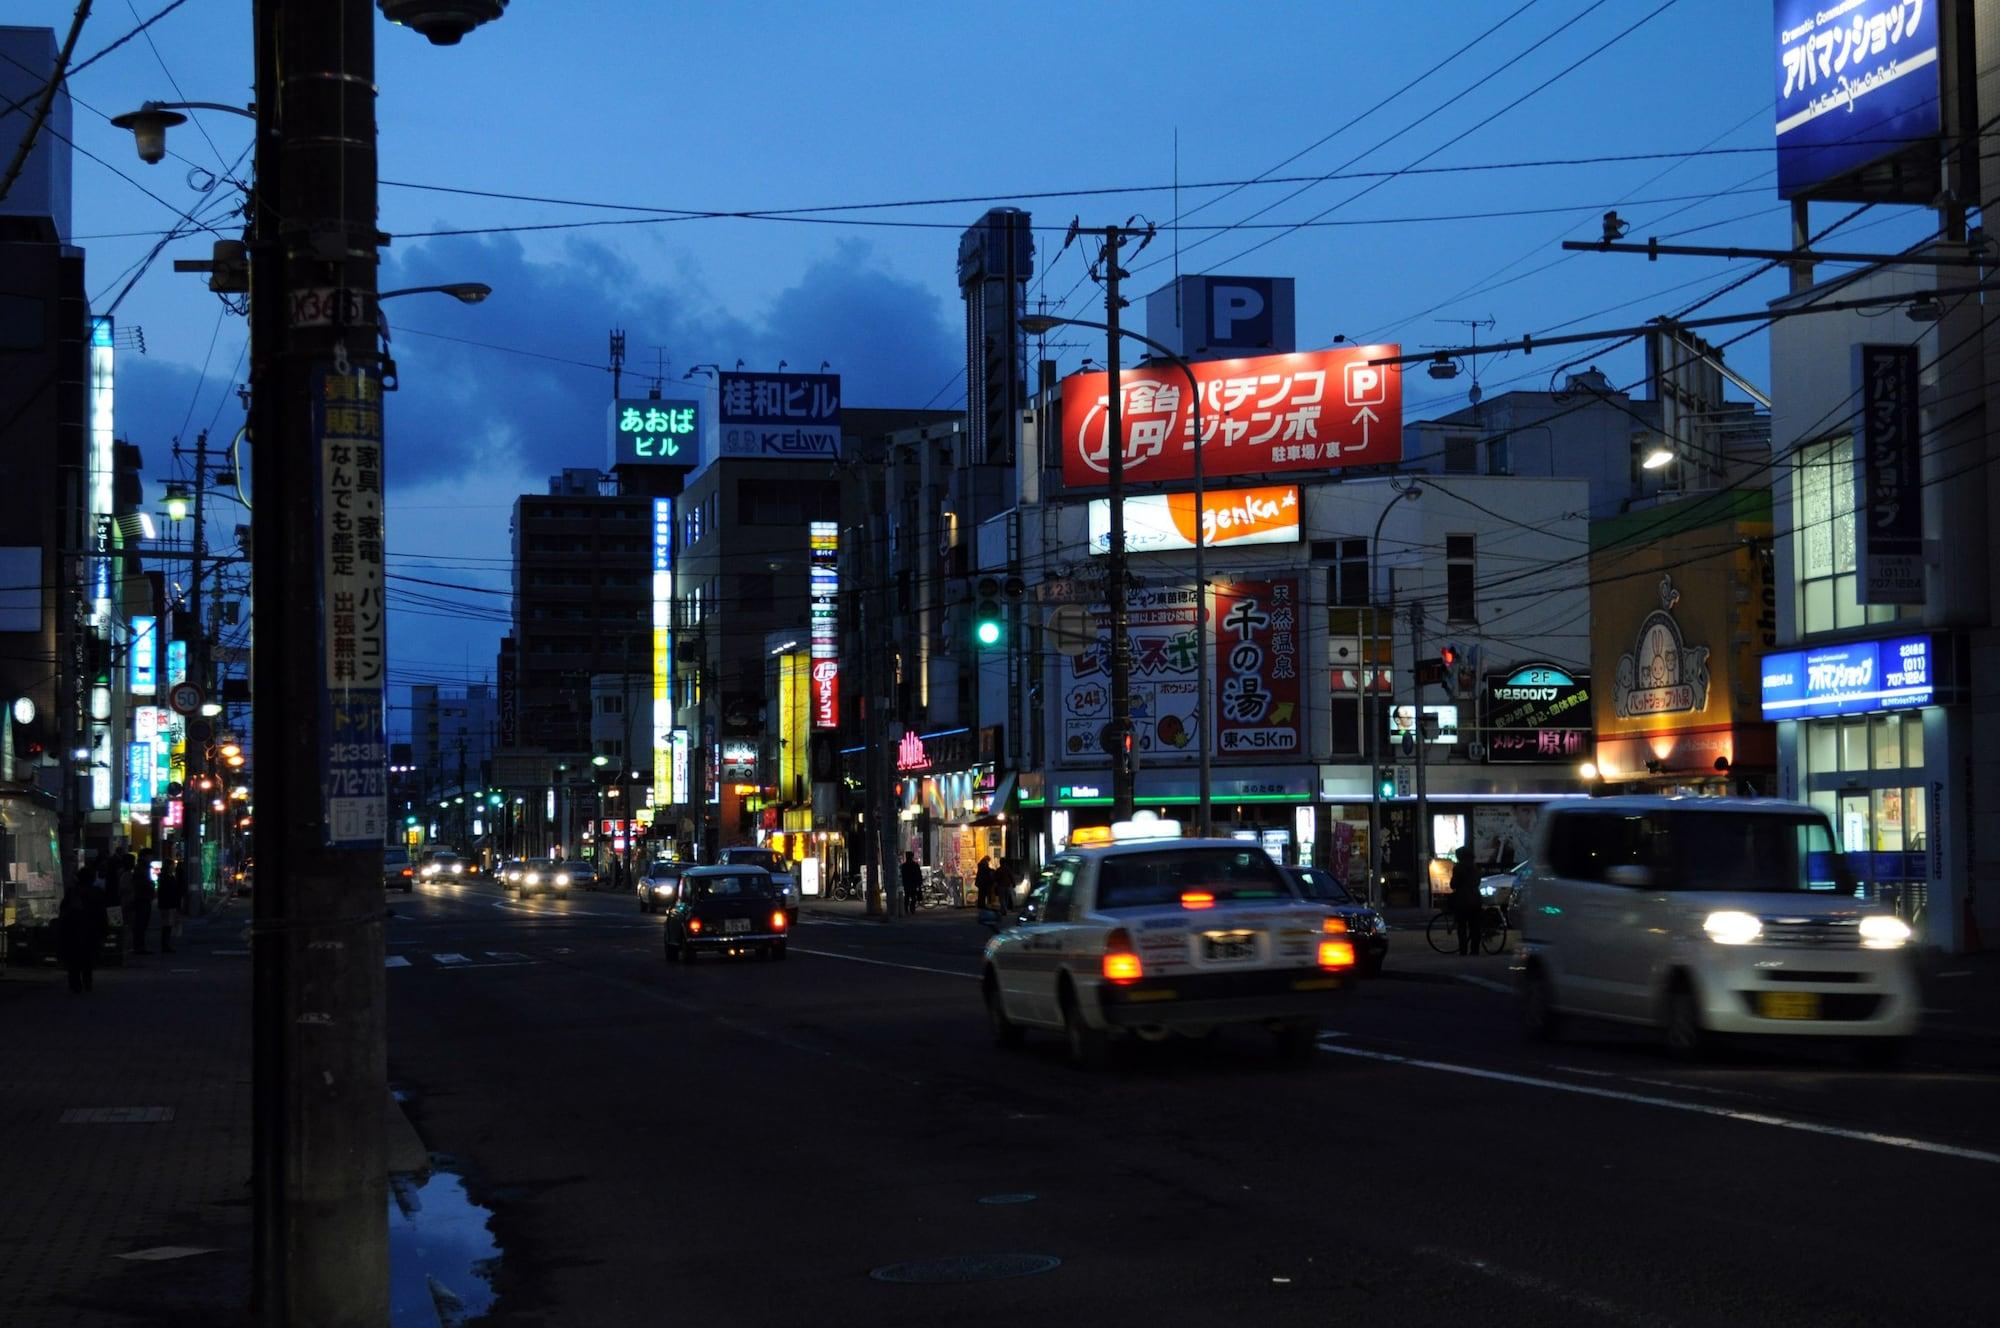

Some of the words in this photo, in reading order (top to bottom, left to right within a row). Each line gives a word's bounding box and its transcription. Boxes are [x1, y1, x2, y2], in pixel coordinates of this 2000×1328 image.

[1213, 286, 1265, 340] P
[723, 378, 838, 418] 桂和ビル
[1127, 384, 1180, 415] 全台
[1187, 370, 1327, 414] パチンコ
[619, 406, 696, 434] あおば
[1183, 405, 1322, 451] ジャンボ
[635, 436, 680, 457] ビル
[1271, 585, 1296, 680] 天然温泉
[1225, 600, 1268, 718] 千の湯
[1531, 672, 1550, 683] 2F
[176, 691, 196, 707] 50
